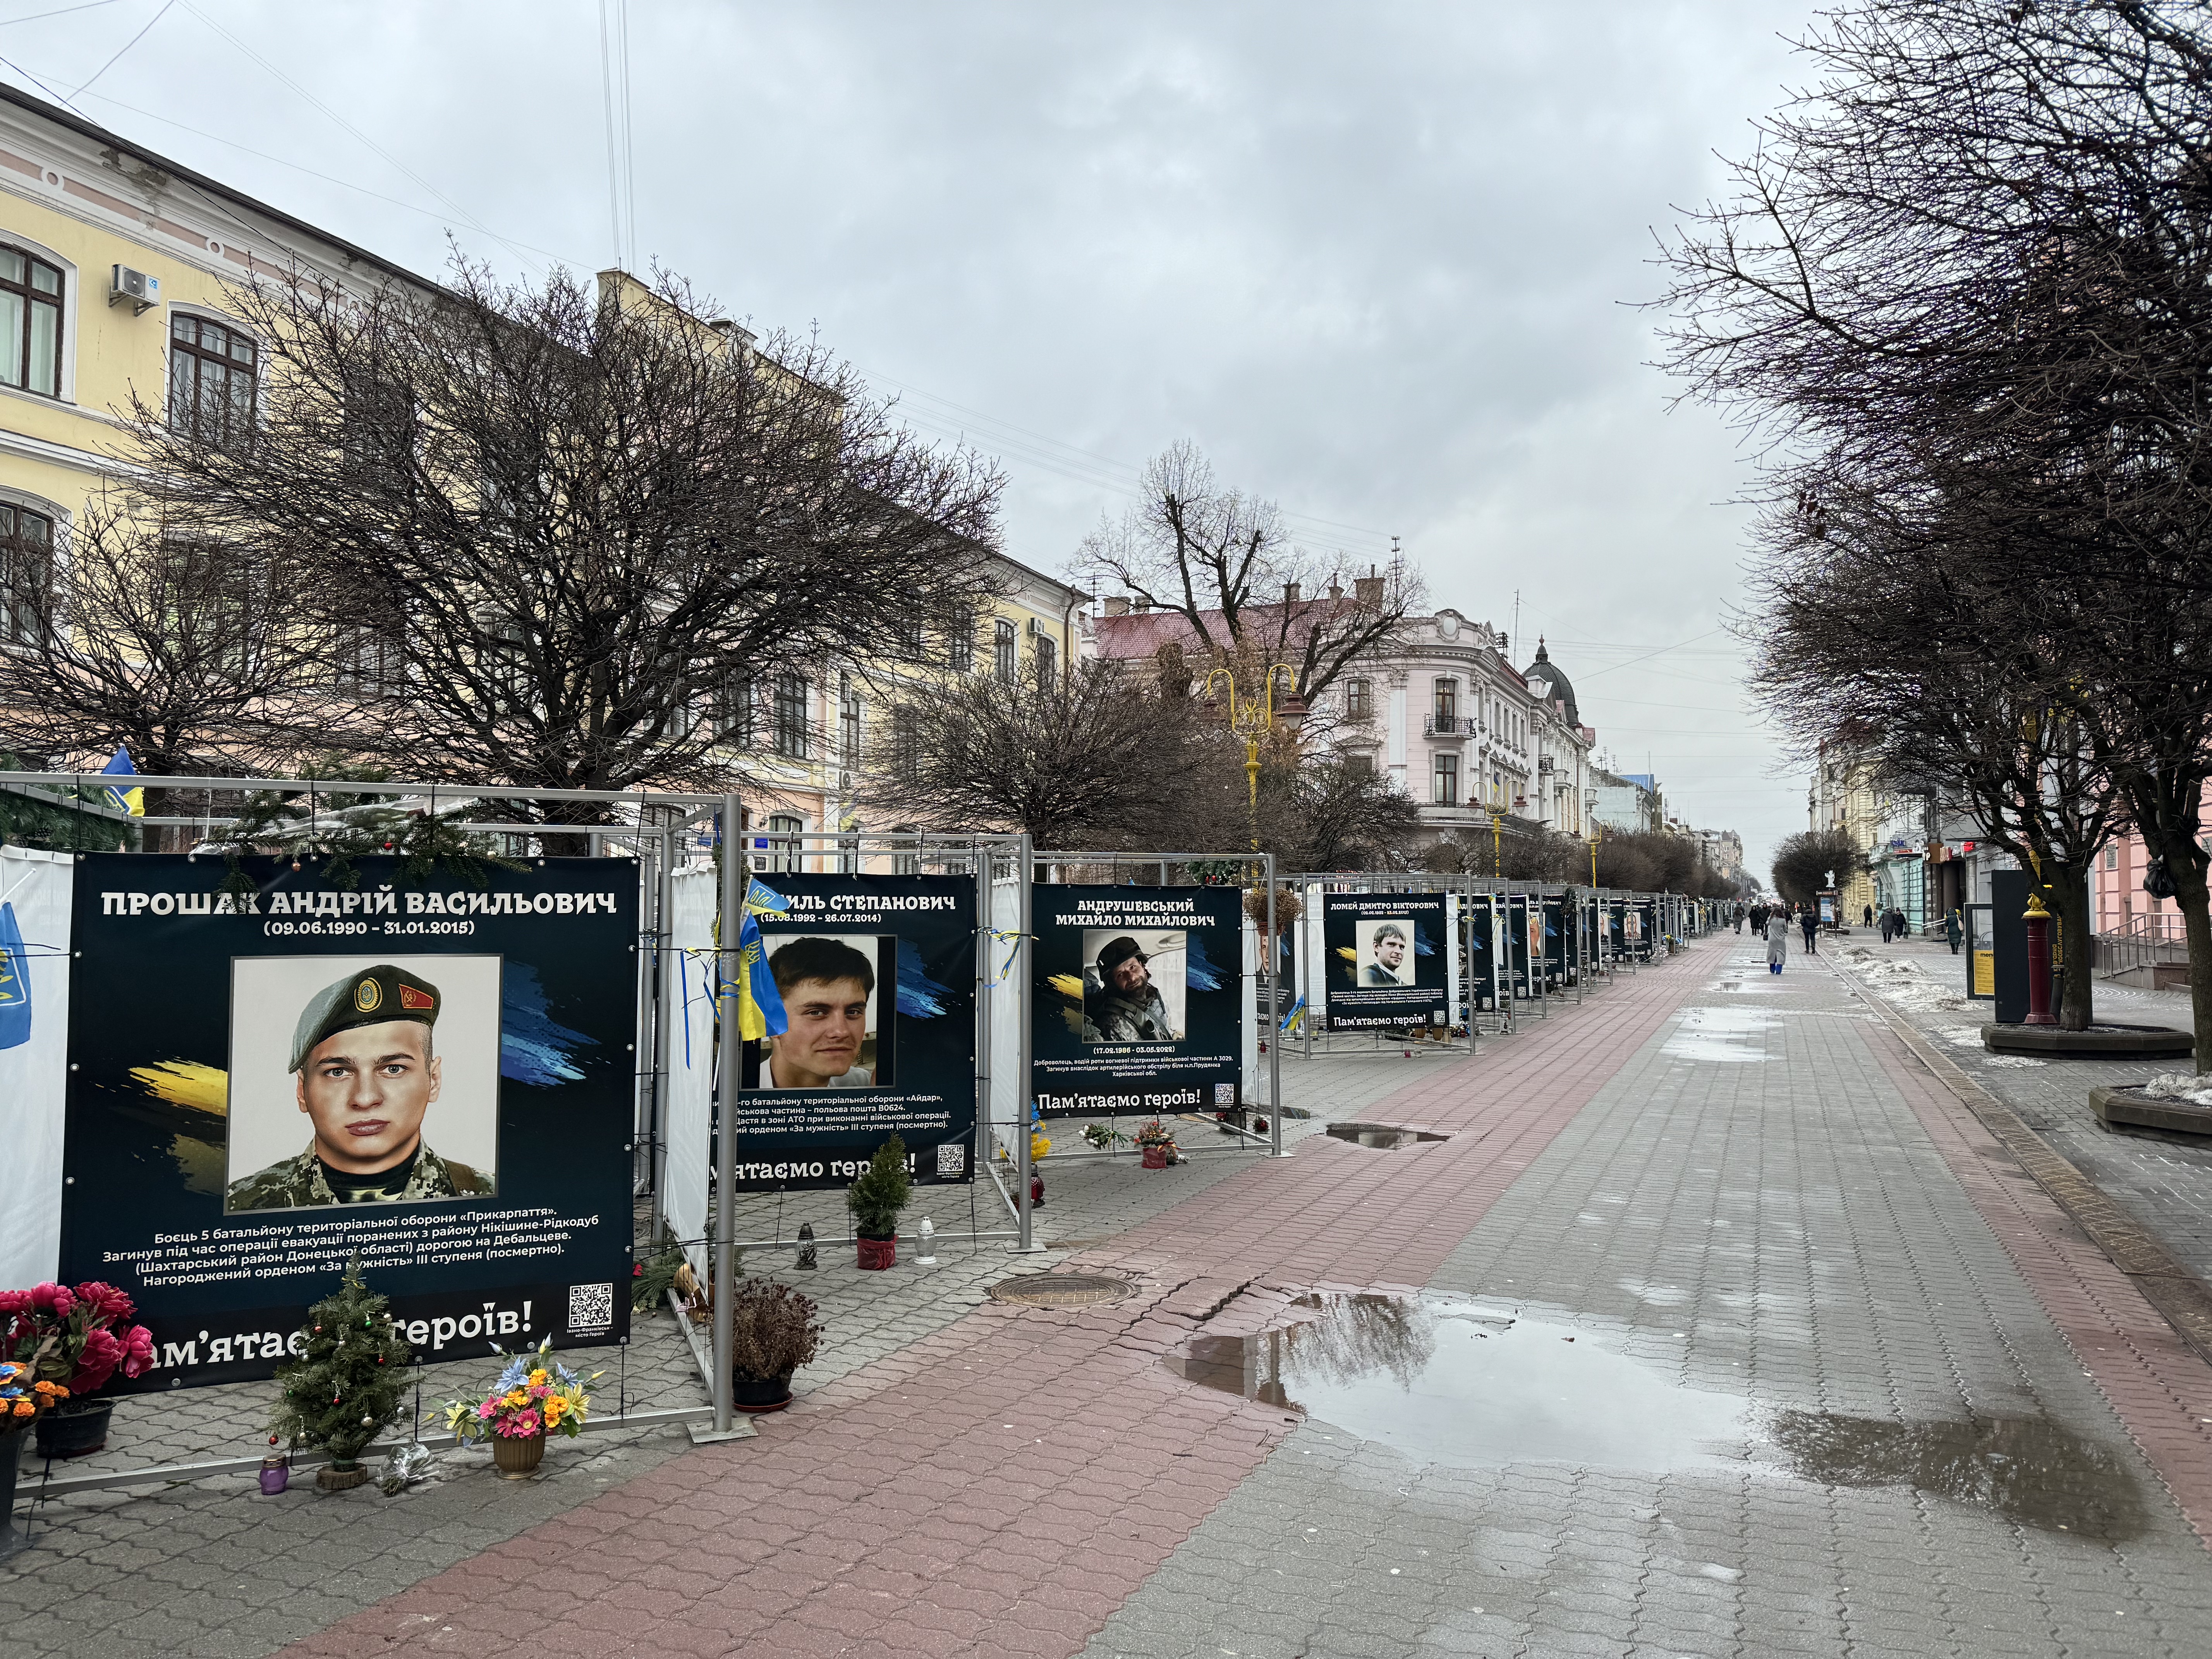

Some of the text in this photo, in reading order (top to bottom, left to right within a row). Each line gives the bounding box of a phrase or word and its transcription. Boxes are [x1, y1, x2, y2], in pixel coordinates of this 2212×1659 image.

[101, 884, 617, 918] ПРОШАК АНДРІЙ ВАСИЛЬОВИЧ
[781, 894, 956, 910] ИЛЬ СТЕПАНОВИЧ
[1077, 898, 1194, 913] АНДРУШЕВСЬКИЙ
[1331, 901, 1358, 910] ЛОМЕЙ
[1359, 902, 1391, 911] ДМИТРО
[761, 913, 816, 923] (15.08.1992
[824, 913, 882, 923] 26.07.2014)
[1056, 910, 1215, 926] МИХАЙЛО МИХАЙЛОВИЧ
[264, 921, 367, 936] (09.06.1990
[384, 920, 475, 935] 31.01.2015)
[1393, 1014, 1426, 1026] героїв!
[752, 1097, 802, 1106] батальйону
[803, 1096, 867, 1106] територіальної
[868, 1095, 904, 1104] оборони
[906, 1094, 943, 1103] «Айдар»,
[1144, 1089, 1200, 1109] героїв!
[826, 1113, 868, 1122] виконанні
[870, 1112, 913, 1121] військової
[915, 1111, 951, 1120] операції.
[806, 1123, 849, 1133] мужність»
[860, 1123, 894, 1132] ступеня
[896, 1120, 948, 1130] (посмертно).
[155, 1208, 557, 1244] Боєць 5 батальйону територіальної оборони «Прикарпаття».
[103, 1250, 162, 1262] Загинув
[166, 1245, 188, 1257] під
[192, 1245, 216, 1254] час
[220, 1238, 278, 1253] операції
[282, 1233, 344, 1248] евакуації
[347, 1230, 419, 1244] поранених
[432, 1225, 478, 1239] району
[481, 1214, 599, 1233] Нікішине-Рідкодуб
[136, 1232, 571, 1276] (Шахтарський район Донецької області) дорогою на Дебальцеве.
[144, 1267, 251, 1286] Нагороджений
[255, 1265, 316, 1279] орденом
[319, 1261, 342, 1271] «За
[431, 1252, 482, 1264] ступеня
[486, 1243, 564, 1261] (посмертно).
[390, 1300, 532, 1350] героїв!
